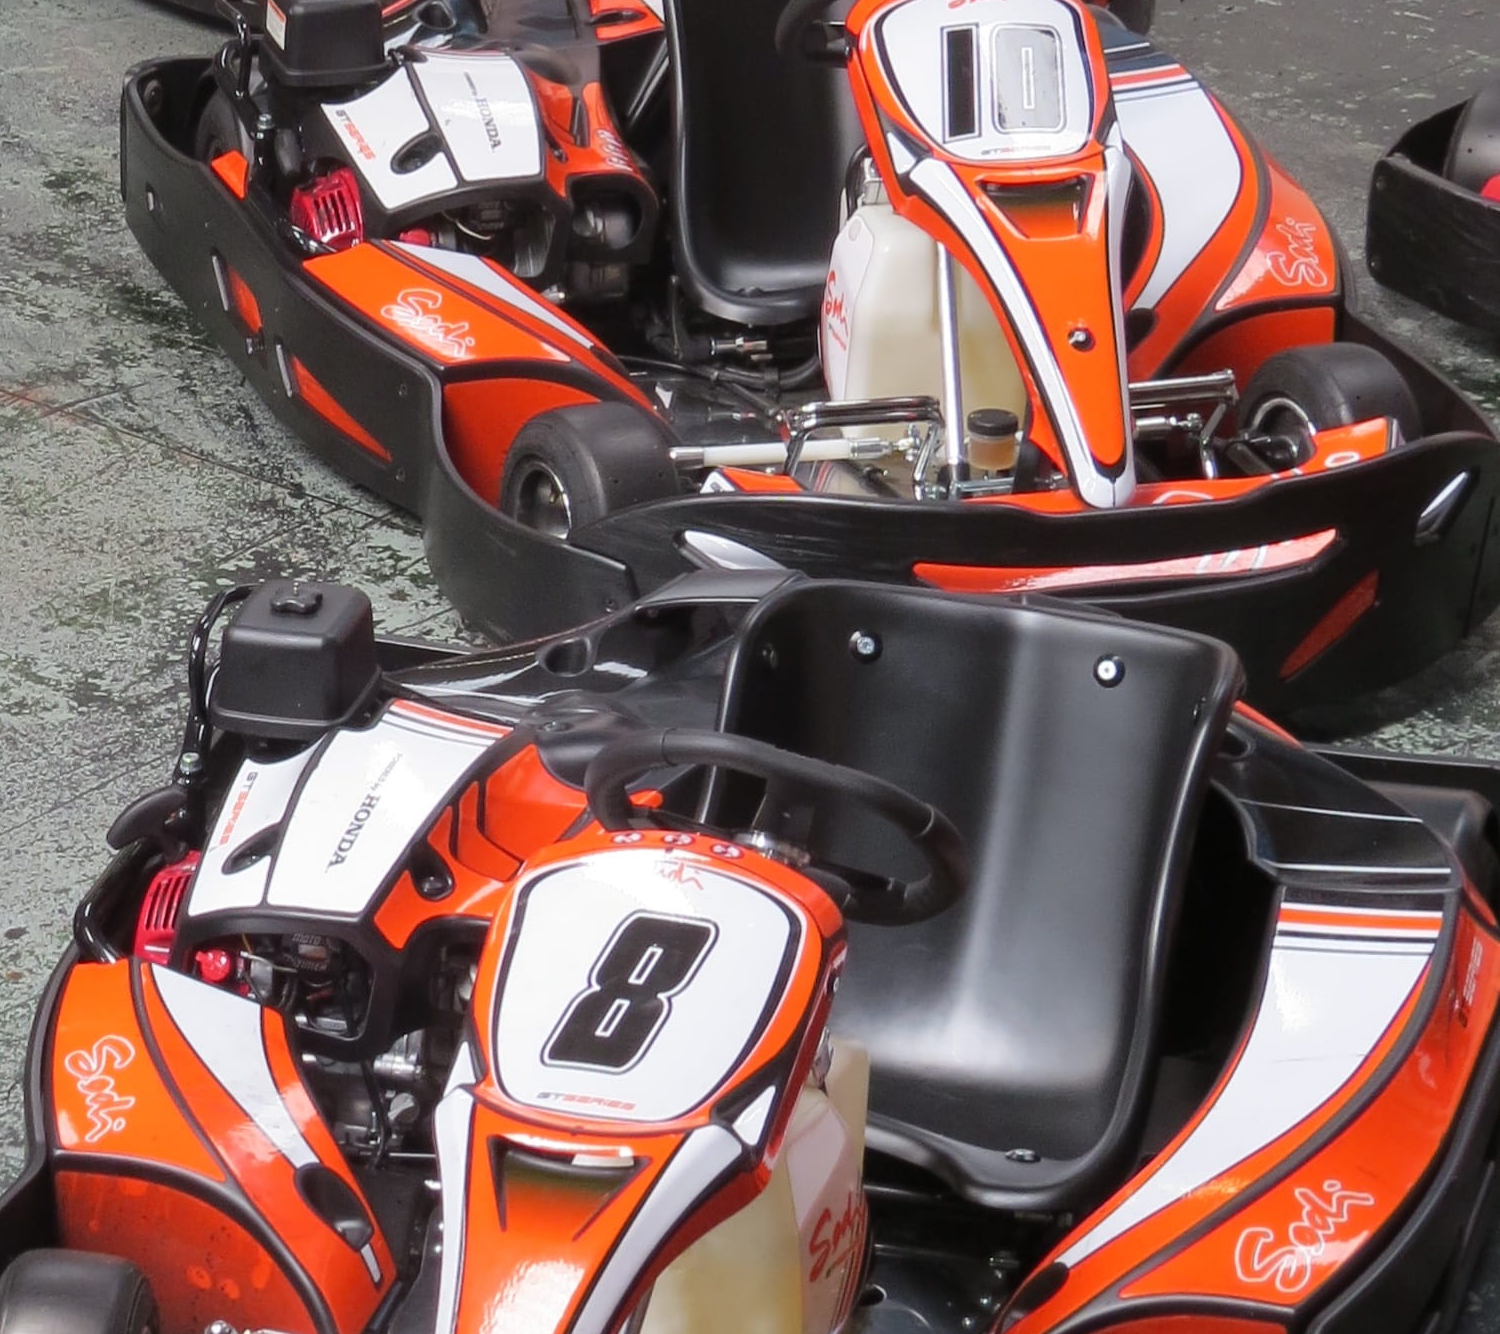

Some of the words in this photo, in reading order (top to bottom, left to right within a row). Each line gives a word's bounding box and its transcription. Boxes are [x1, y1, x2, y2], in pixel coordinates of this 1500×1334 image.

[941, 23, 1067, 144] 10
[475, 97, 503, 153] HONDA
[1265, 216, 1328, 288] Sodi
[380, 287, 476, 357] Sodi
[326, 793, 381, 872] HONDA
[541, 909, 719, 1075] 8
[64, 1034, 136, 1143] Sodi
[536, 1091, 637, 1112] GTSERIES
[1235, 1179, 1375, 1293] Sodi
